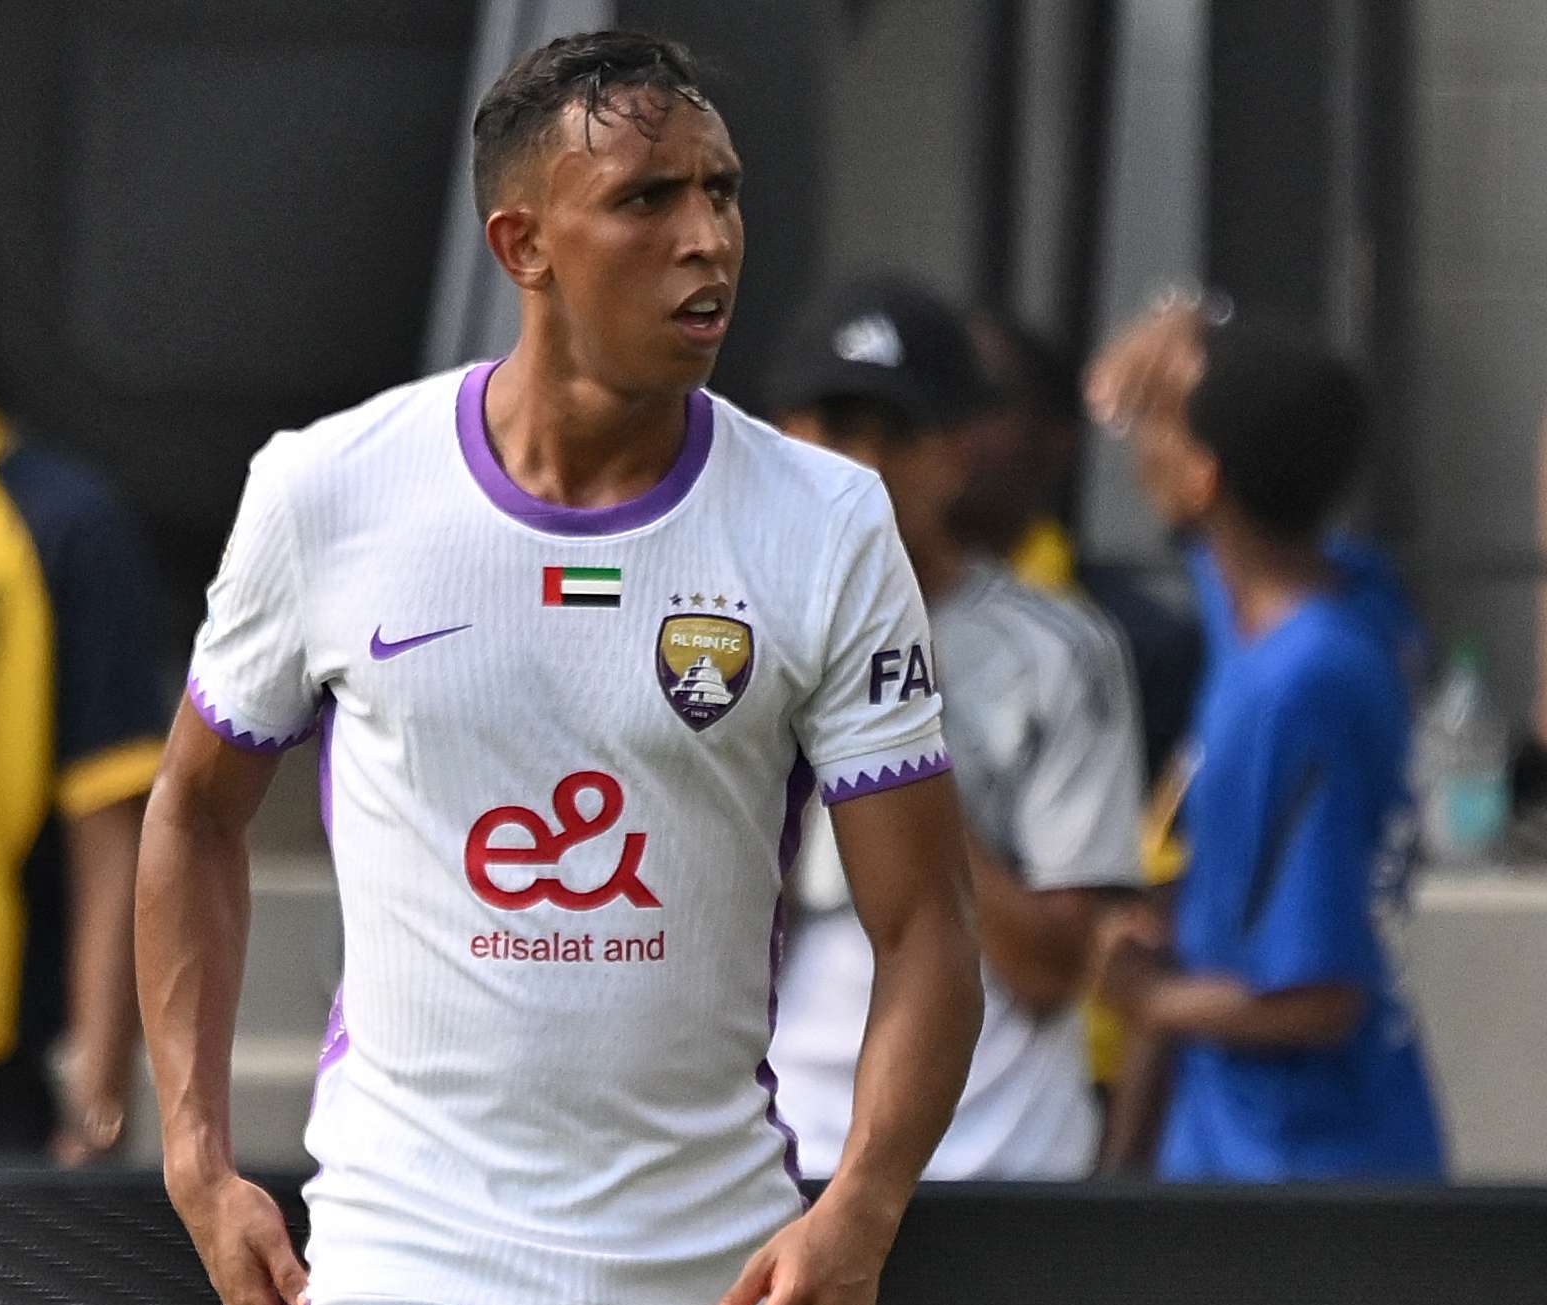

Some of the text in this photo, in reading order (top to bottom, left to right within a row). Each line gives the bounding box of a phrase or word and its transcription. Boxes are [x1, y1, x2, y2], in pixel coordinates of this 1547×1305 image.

[670, 633, 690, 647] AL
[721, 638, 741, 652] FC
[869, 644, 937, 705] FA
[469, 930, 666, 961] etisalat and
